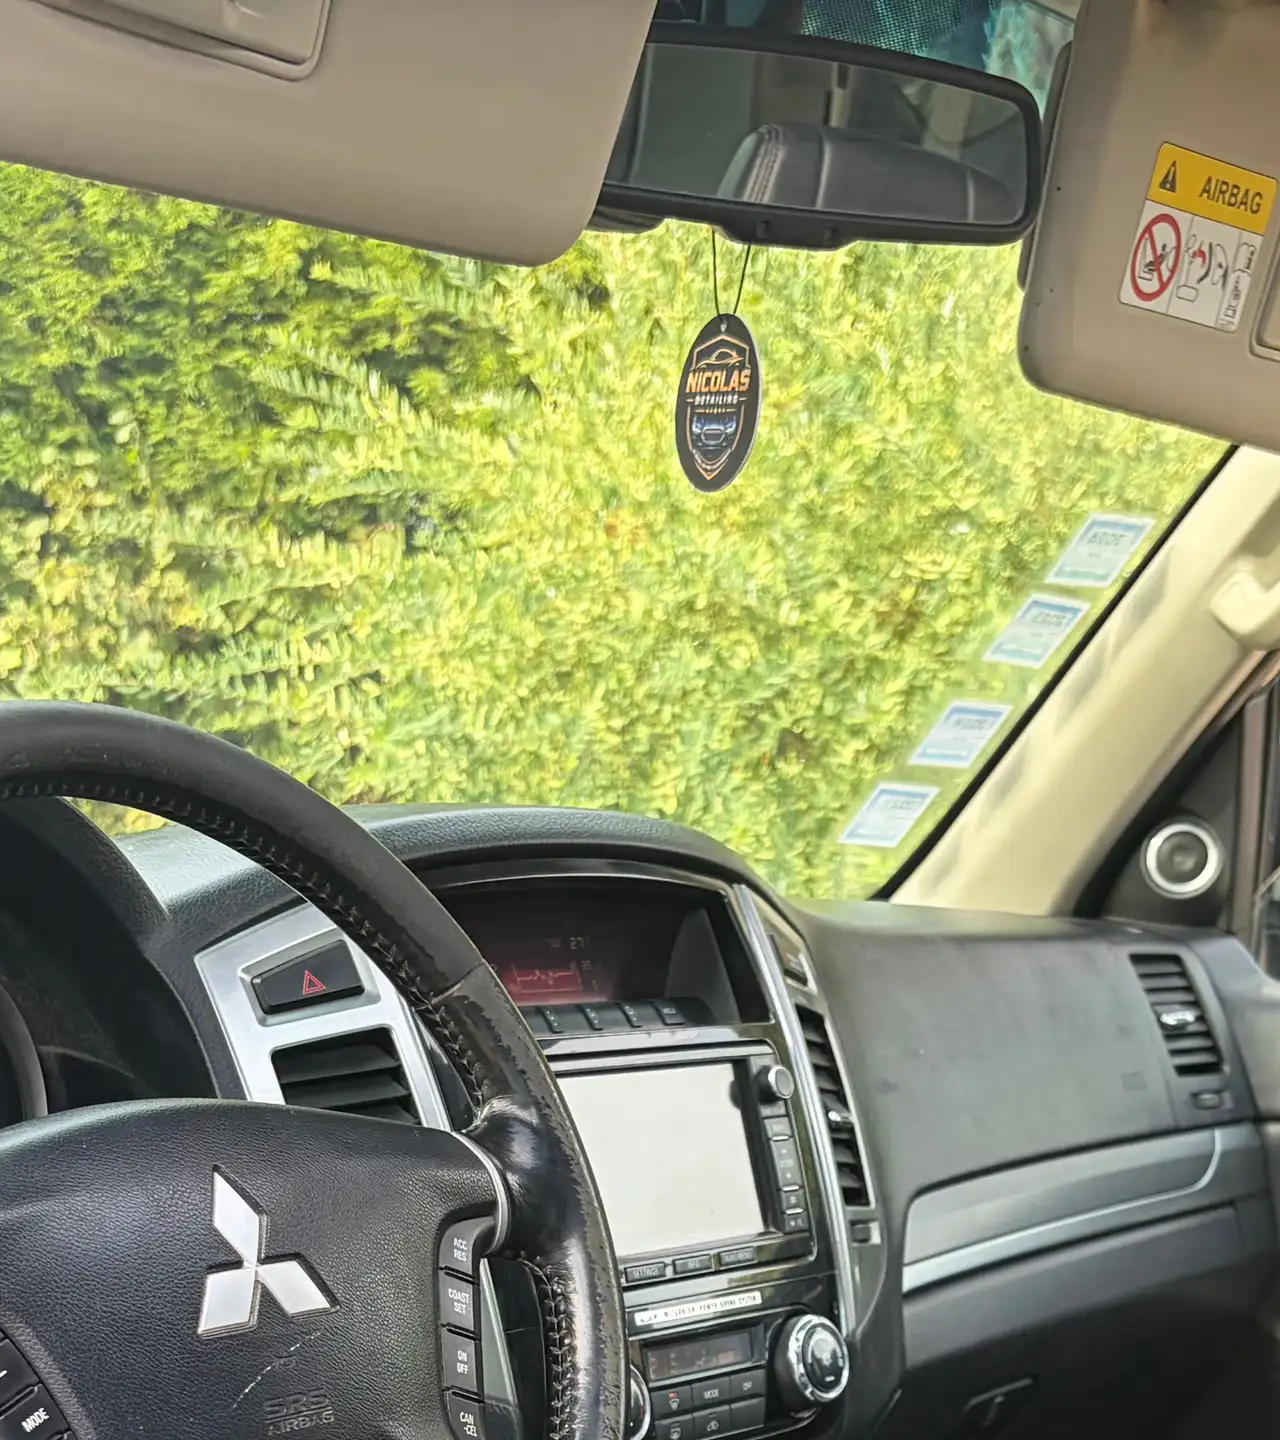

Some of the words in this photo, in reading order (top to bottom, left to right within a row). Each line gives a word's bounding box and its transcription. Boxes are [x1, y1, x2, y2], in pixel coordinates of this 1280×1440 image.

[1199, 176, 1263, 214] AIRBAG
[686, 369, 751, 392] NICOLAS
[453, 1237, 468, 1251] ACC
[453, 1248, 467, 1262] RES
[448, 1288, 469, 1304] COAST
[453, 1302, 466, 1315] SET
[457, 1350, 468, 1362] ON
[456, 1362, 469, 1375] OFF
[704, 1388, 720, 1399] MODE
[263, 1388, 329, 1418] SRS
[21, 1407, 50, 1432] MODE
[266, 1409, 335, 1436] AIRBAG
[460, 1411, 475, 1425] CAN
